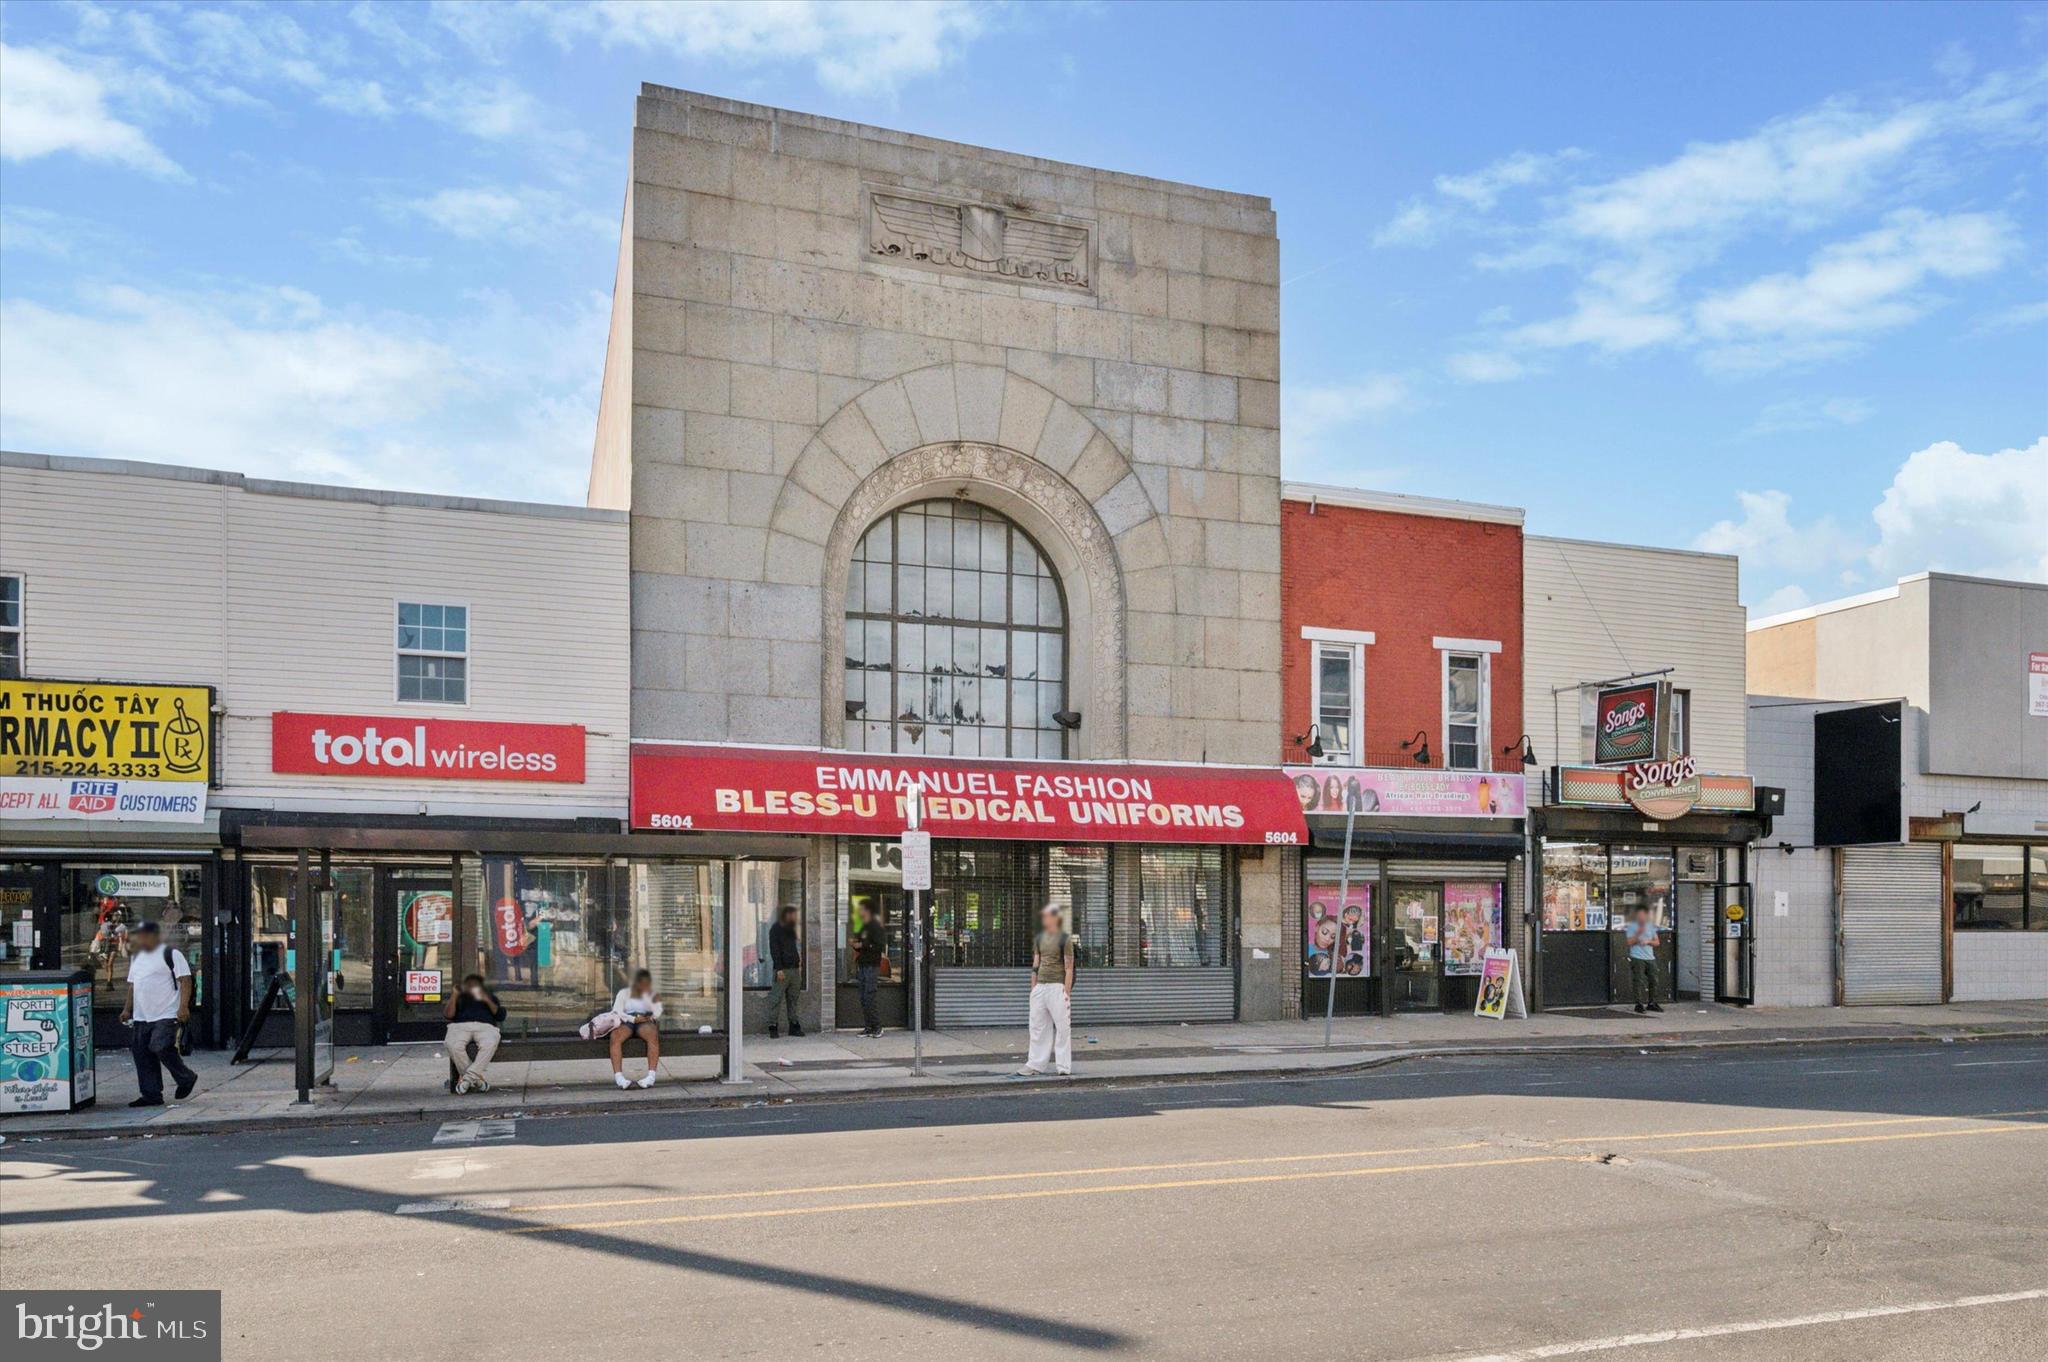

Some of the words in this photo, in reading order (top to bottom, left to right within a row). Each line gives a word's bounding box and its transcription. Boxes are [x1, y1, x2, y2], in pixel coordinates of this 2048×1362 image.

[23, 687, 104, 714] THUỐC
[115, 692, 159, 715] TÂY
[0, 716, 121, 759] RMACY
[312, 726, 426, 768] total
[431, 743, 558, 772] wireless
[16, 760, 161, 778] 215-224-3333
[75, 782, 114, 796] RITE
[816, 766, 1008, 796] EMMANUEL
[1015, 775, 1153, 801] FASHION
[0, 791, 35, 809] CEPT
[37, 792, 61, 809] ALL
[76, 798, 107, 811] AID
[120, 794, 197, 812] CUSTOMERS
[715, 788, 877, 818] BLESS-U
[1069, 801, 1245, 828] UNIFORMS
[650, 813, 693, 829] 5604
[1265, 831, 1297, 844] 5604
[120, 880, 147, 888] Health
[149, 881, 166, 889] Mart
[0, 891, 30, 904] ARMACY
[497, 905, 519, 949] total
[409, 973, 438, 985] Fios
[410, 984, 417, 992] is
[418, 984, 437, 992] here
[10, 1000, 54, 1010] NORTH
[5, 1042, 55, 1054] STREET
